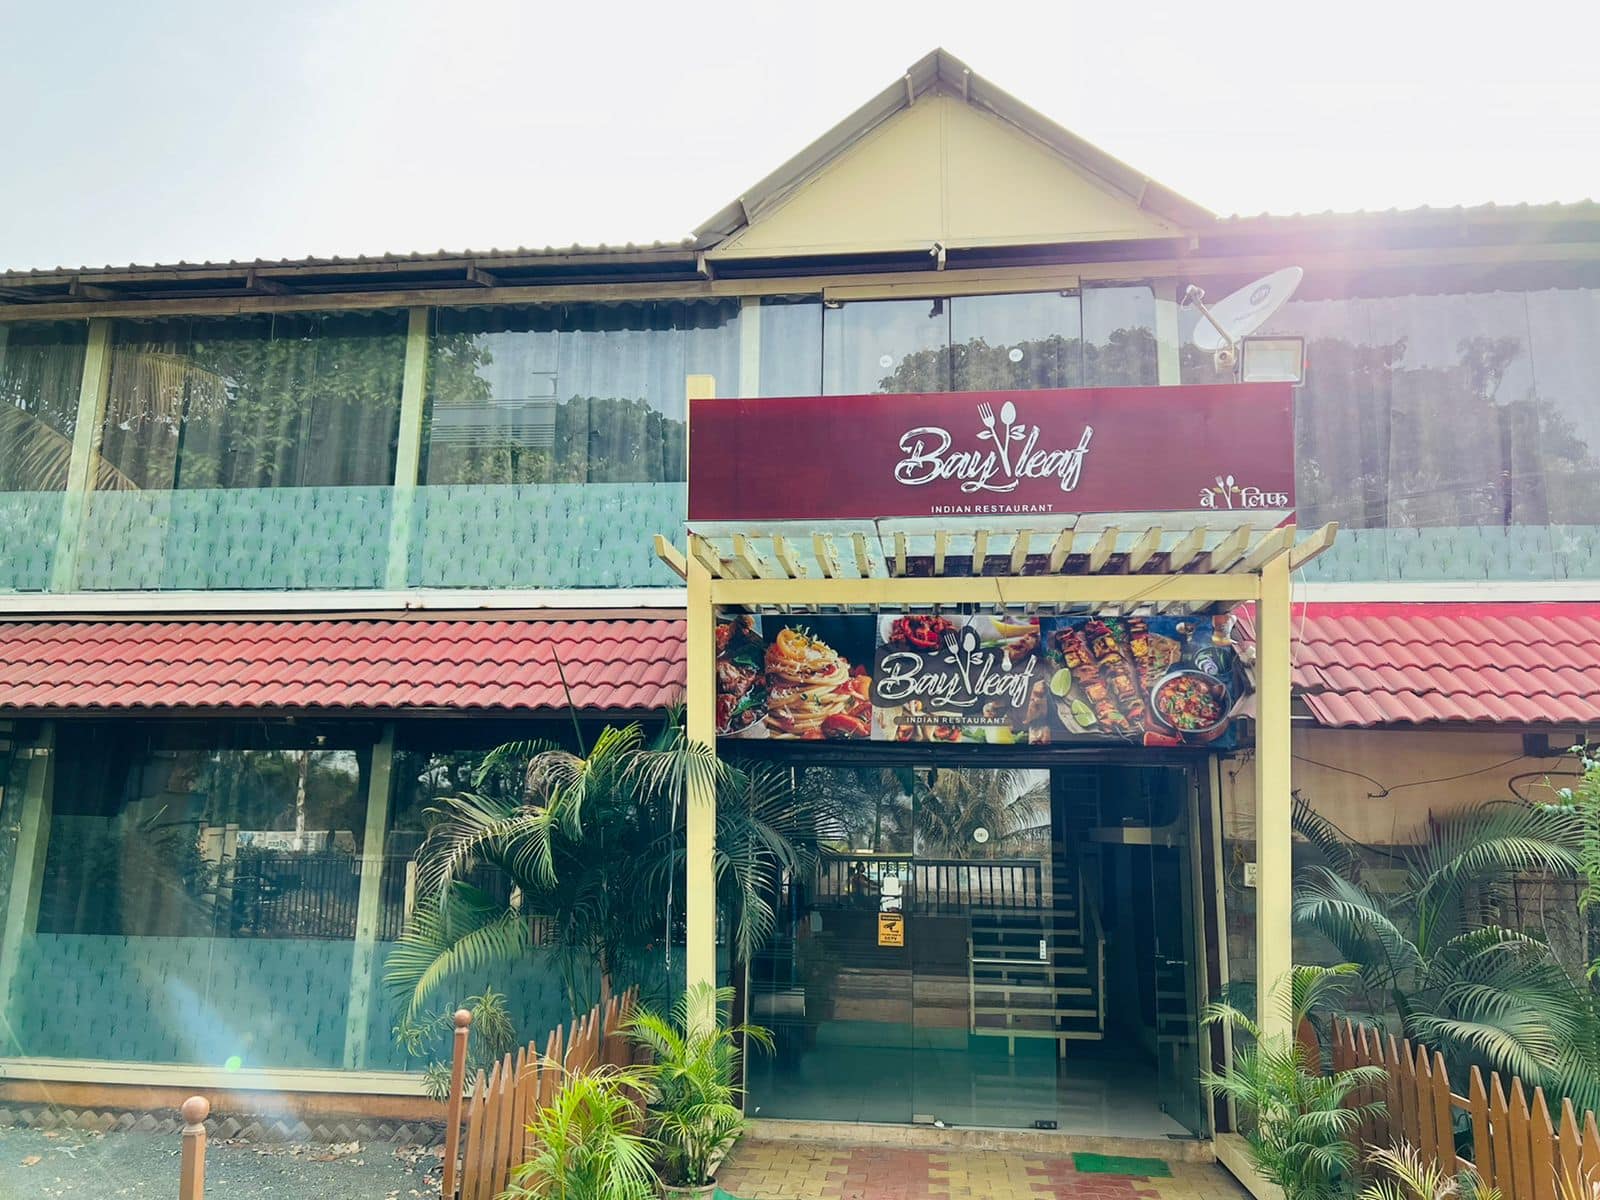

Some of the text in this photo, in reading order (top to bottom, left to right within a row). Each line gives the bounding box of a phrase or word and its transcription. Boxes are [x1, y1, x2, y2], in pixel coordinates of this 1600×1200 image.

[894, 425, 1094, 493] Bay leaf
[1240, 487, 1289, 508] लिफ
[931, 503, 1054, 514] INDIAN RESTAURANT
[877, 651, 1038, 708] Bay leaf
[906, 716, 1006, 725] INDIAN RESTAURANT
